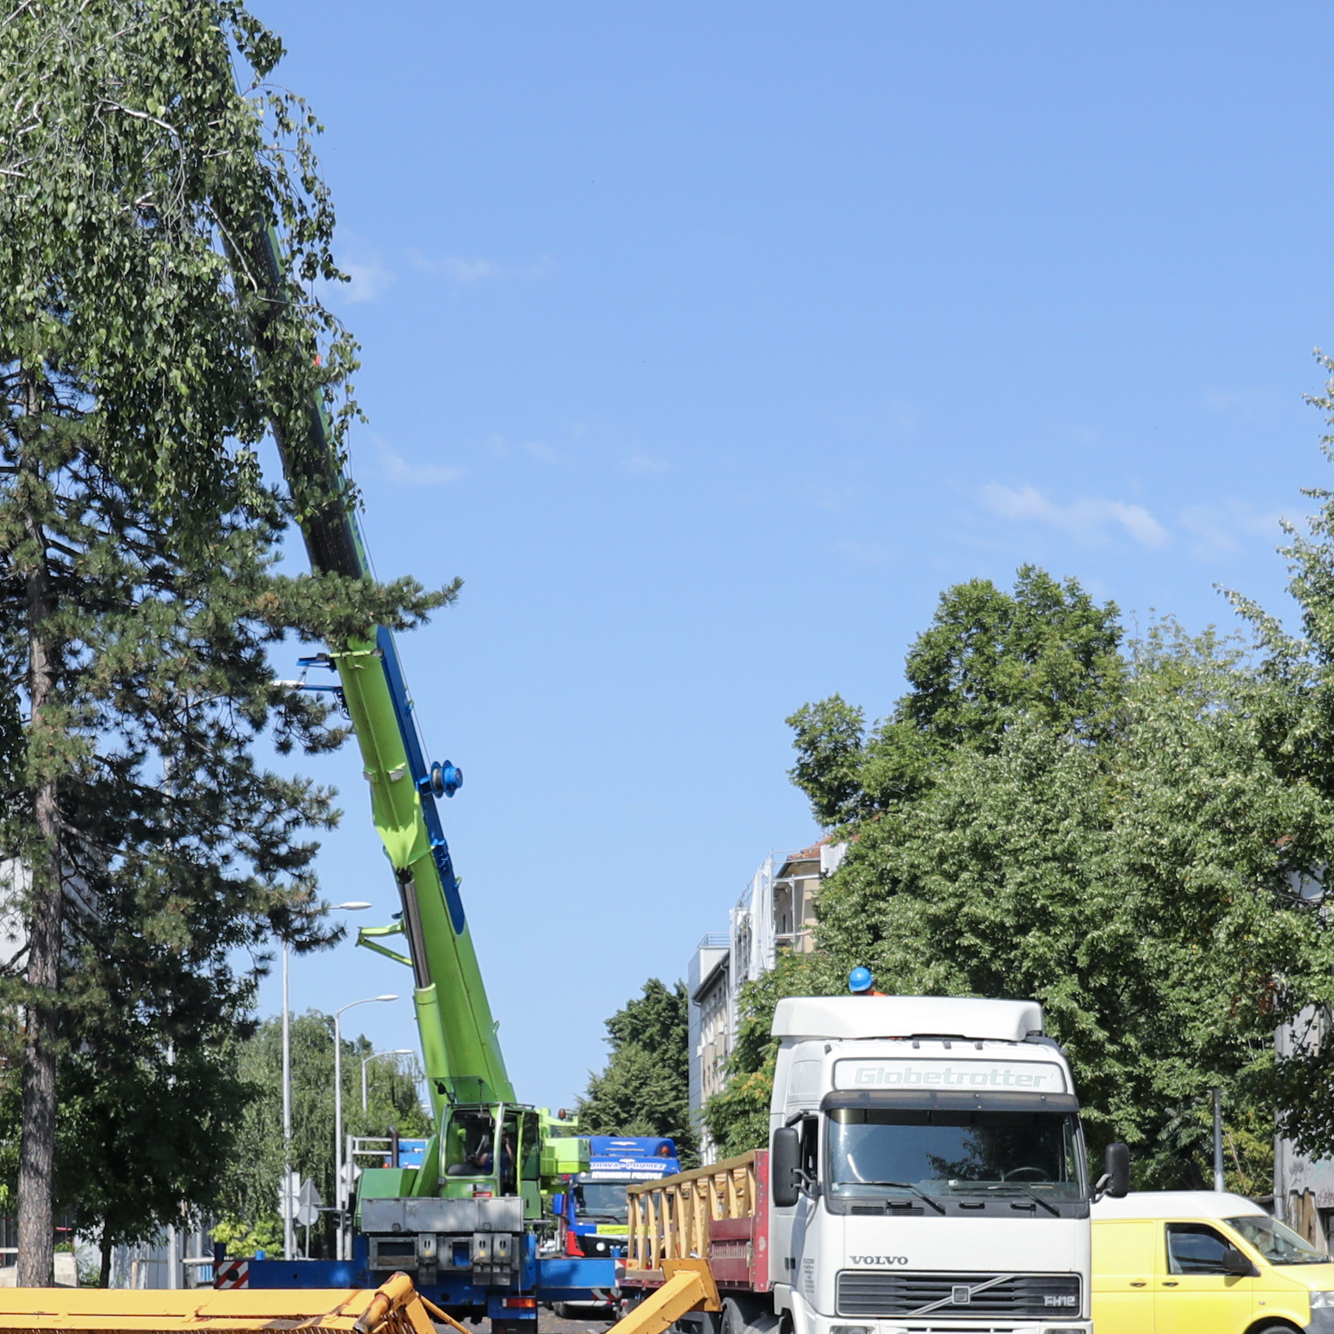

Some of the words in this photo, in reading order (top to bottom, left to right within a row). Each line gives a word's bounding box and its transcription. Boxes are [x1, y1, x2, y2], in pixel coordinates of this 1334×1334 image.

[854, 1067, 1048, 1088] Globetrotter
[849, 1256, 909, 1265] VOLVO
[1043, 1295, 1076, 1307] FH12
